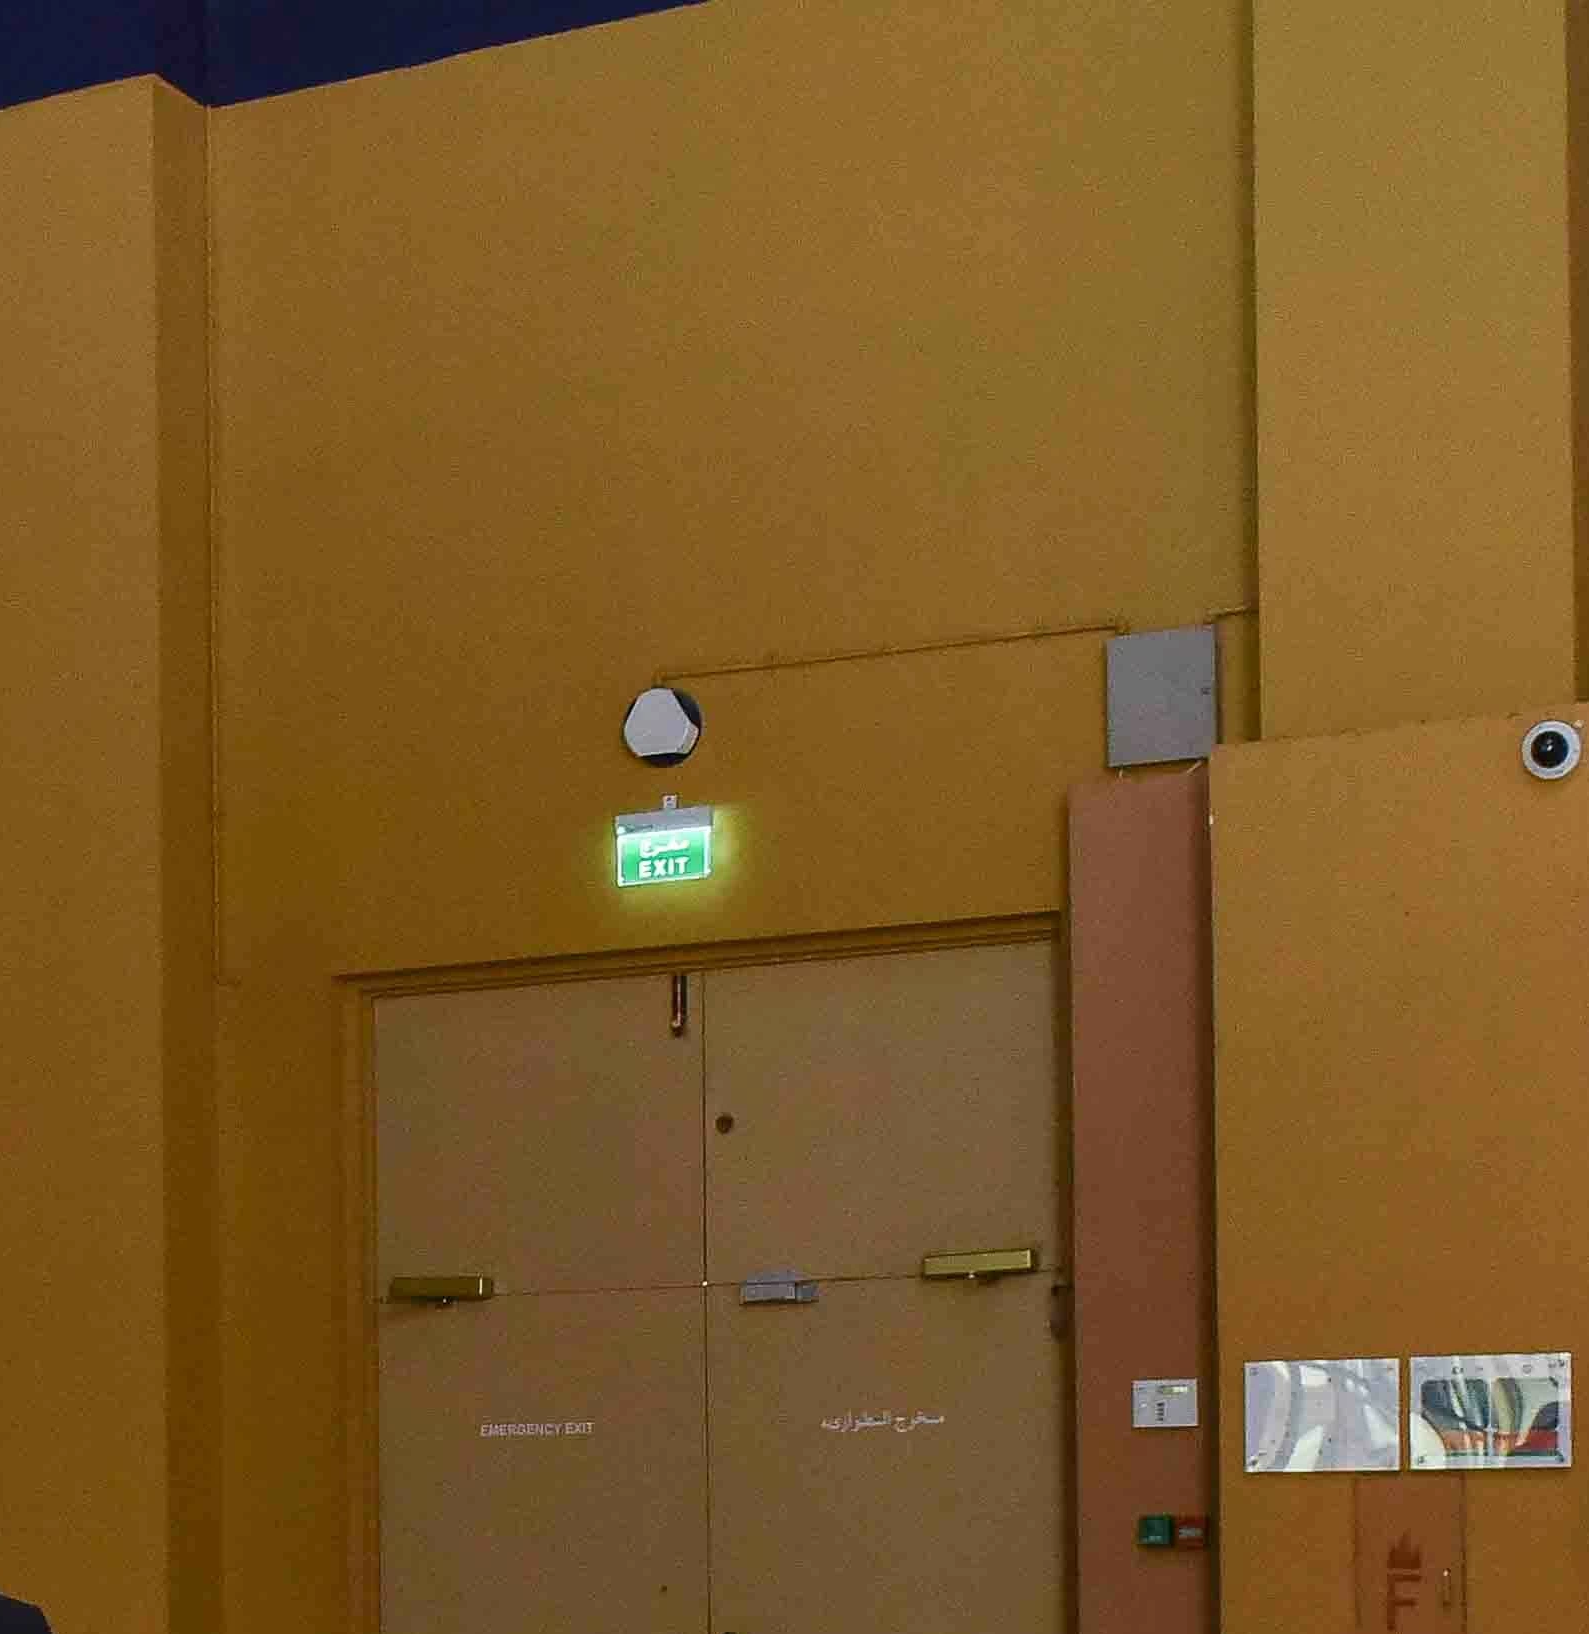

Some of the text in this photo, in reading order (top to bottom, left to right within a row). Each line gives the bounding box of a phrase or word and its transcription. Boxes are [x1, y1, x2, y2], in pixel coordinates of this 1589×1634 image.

[639, 856, 690, 878] EXIT
[480, 1421, 596, 1437] EMERGENCY EXIT
